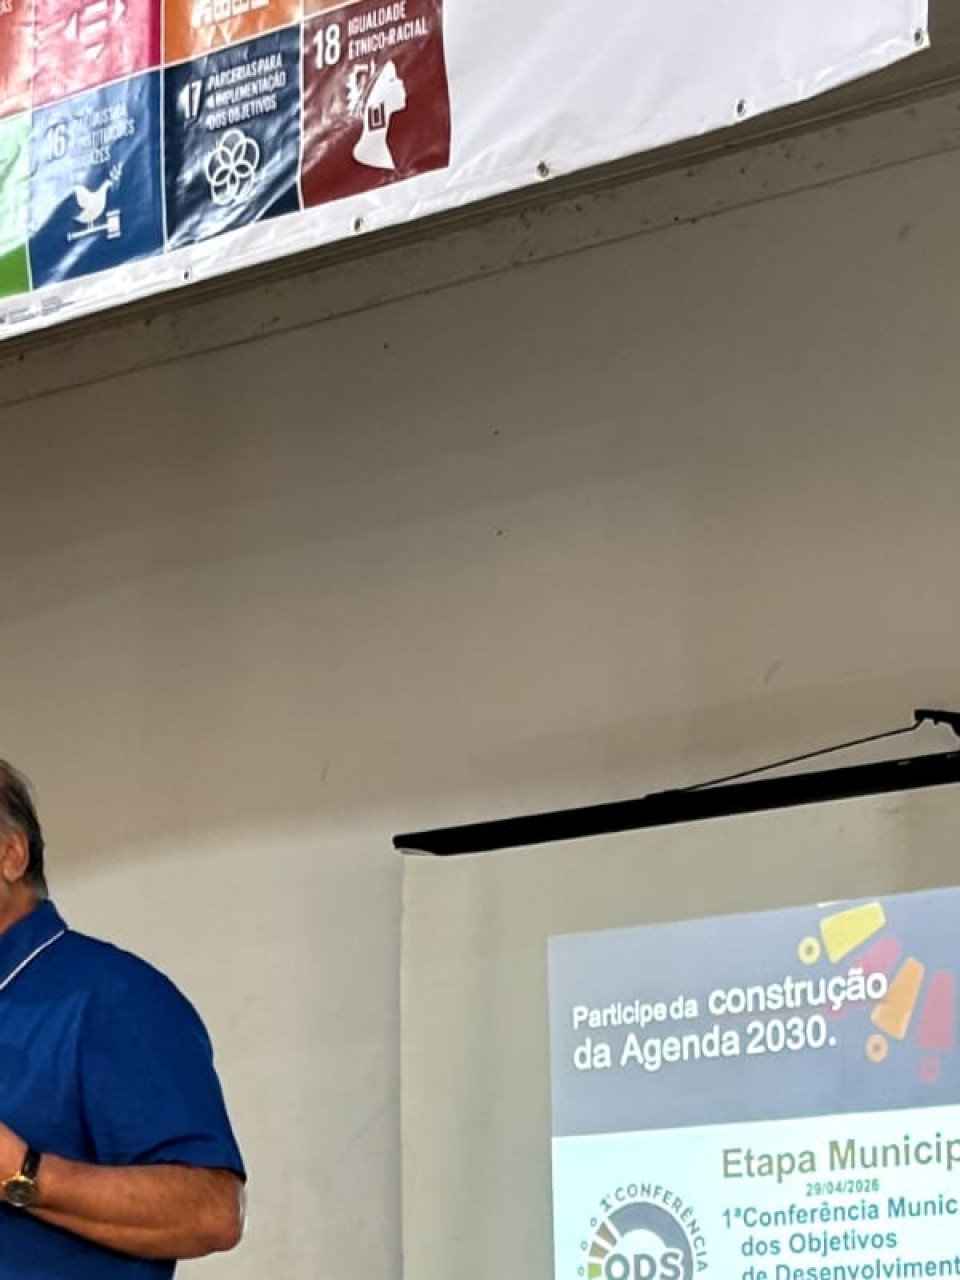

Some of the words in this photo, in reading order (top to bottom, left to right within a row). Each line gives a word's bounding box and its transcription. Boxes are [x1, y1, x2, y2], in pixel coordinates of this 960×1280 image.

[348, 1, 407, 38] IGUALDADE
[313, 23, 340, 70] 18
[206, 60, 257, 92] PARCERIAS
[257, 52, 283, 75] PARA
[215, 69, 287, 107] IMPLEMENTAÇÃO
[178, 79, 202, 119] 17
[205, 110, 228, 131] DOS
[228, 93, 278, 124] OBJETIVOS
[573, 999, 665, 1029] Participe
[670, 995, 698, 1019] da
[709, 967, 888, 1010] construção
[573, 1037, 611, 1070] da
[620, 1025, 740, 1071] Agenda
[746, 1014, 837, 1054] 2030.
[722, 1147, 816, 1184] Etapa
[805, 1178, 880, 1197] 29/04/2026
[888, 1193, 959, 1218] Munic
[741, 1235, 781, 1256] dos
[789, 1229, 897, 1257] Objetivos
